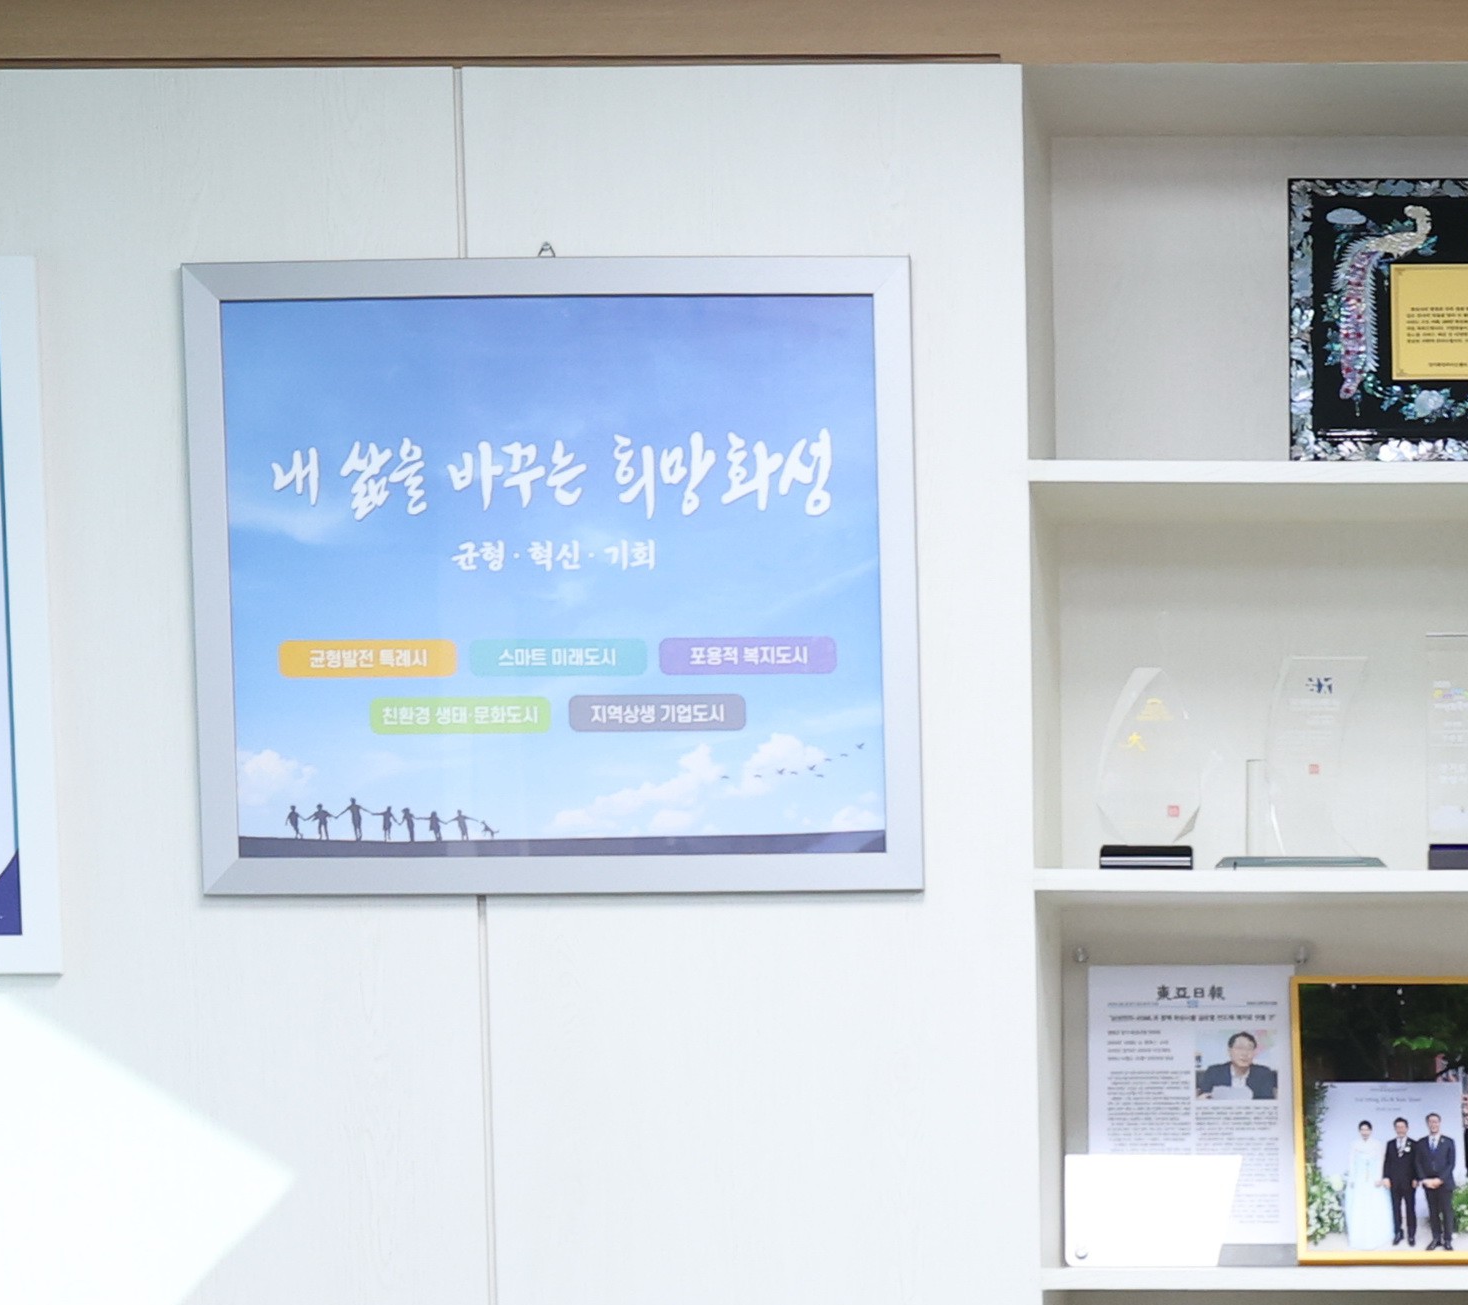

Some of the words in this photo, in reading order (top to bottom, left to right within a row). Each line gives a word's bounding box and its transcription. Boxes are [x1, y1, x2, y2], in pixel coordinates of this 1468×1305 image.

[271, 448, 319, 505] 내
[340, 437, 427, 520] 삶을
[447, 440, 587, 511] 바꾸는
[614, 431, 716, 519] 희망
[722, 428, 832, 517] 화성
[452, 539, 506, 572] 균형
[527, 539, 580, 572] 혁신
[604, 539, 655, 572] 기회
[309, 648, 374, 668] 균형발전
[379, 648, 427, 668] 특례시
[498, 647, 547, 667] 스마트
[552, 647, 617, 666] 미래도시
[689, 646, 740, 665] 포용적
[744, 646, 808, 665] 복지도시
[382, 706, 430, 725] 친환경
[591, 704, 655, 724] 지역상생
[660, 704, 725, 723] 기업도시
